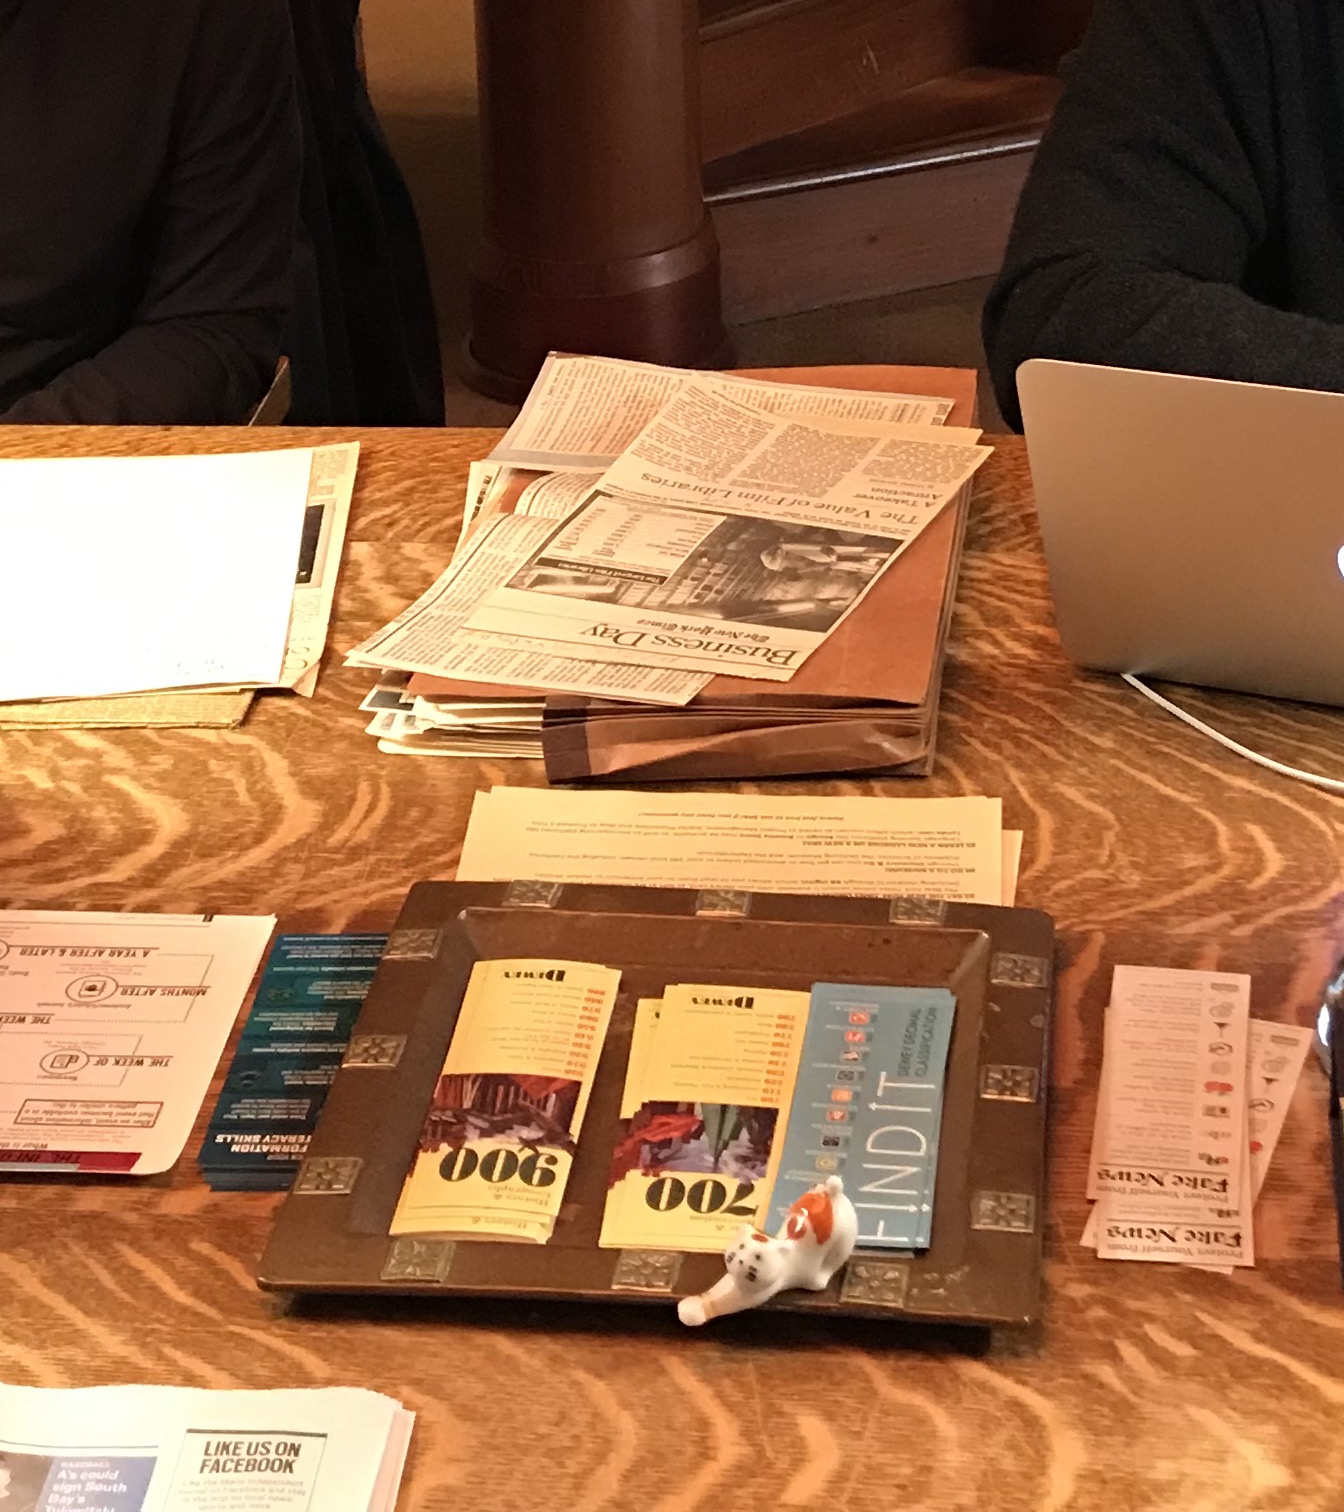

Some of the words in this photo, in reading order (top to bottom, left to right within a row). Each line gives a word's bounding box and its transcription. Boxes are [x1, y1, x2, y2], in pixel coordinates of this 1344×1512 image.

[640, 472, 733, 498] Libraries
[736, 491, 787, 506] Film
[870, 485, 943, 501] Attraction
[788, 499, 810, 509] of
[853, 493, 920, 507] Takeover
[813, 502, 872, 519] Value
[879, 511, 918, 525] The
[637, 619, 678, 632] Times
[680, 625, 714, 636] York
[578, 623, 648, 647] Day
[713, 629, 743, 640] New
[743, 631, 770, 644] The
[650, 635, 801, 666] Business
[19, 948, 55, 957] LATER
[68, 948, 106, 957] AFTER
[108, 949, 137, 958] YEAR
[120, 988, 157, 996] AFTER
[160, 988, 207, 996] MONTHS
[29, 1016, 51, 1024] THE
[903, 1008, 921, 1045] DECIMAL
[914, 1006, 938, 1077] CLASSIFICATION
[113, 1058, 144, 1067] WEEK
[149, 1058, 170, 1067] THE
[897, 1046, 914, 1077] DEWEY
[867, 1071, 936, 1113] IT
[214, 1133, 261, 1143] SKILLS
[439, 1145, 557, 1187] 900
[854, 1125, 928, 1242] FIND
[1096, 1169, 1169, 1187] News
[1171, 1175, 1229, 1193] Fake
[645, 1177, 759, 1217] 700
[1096, 1186, 1127, 1195] from
[1128, 1188, 1180, 1199] Yourself
[507, 1194, 548, 1207] History
[1183, 1193, 1229, 1203] Protect
[1106, 1226, 1181, 1243] News
[1183, 1230, 1243, 1248] Fake
[1106, 1244, 1138, 1253] from
[1141, 1247, 1194, 1257] Yourself
[1197, 1249, 1243, 1258] Protect
[203, 1440, 245, 1458] LIKE
[246, 1441, 272, 1458] US
[274, 1441, 302, 1458] ON
[199, 1458, 297, 1474] FACEBOOK
[57, 1469, 76, 1480] A's
[79, 1468, 120, 1480] could
[52, 1482, 82, 1494] sign
[84, 1481, 127, 1493] South
[47, 1492, 86, 1506] Bay's
